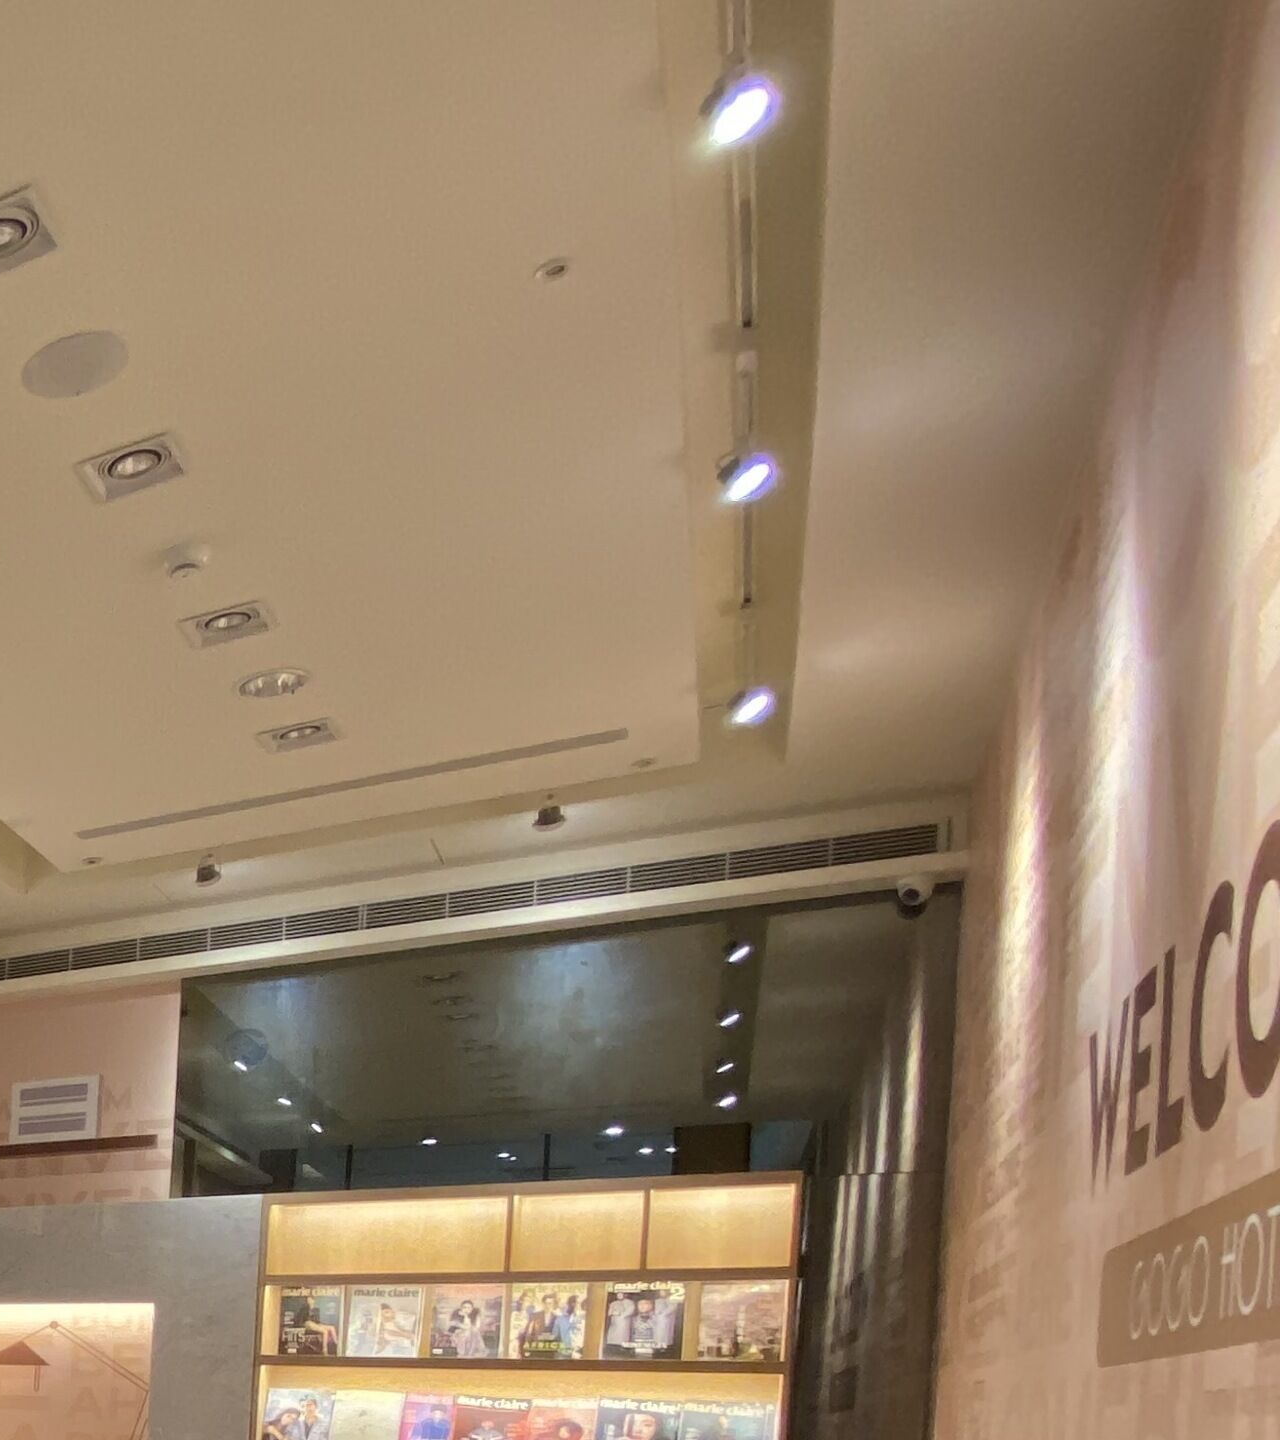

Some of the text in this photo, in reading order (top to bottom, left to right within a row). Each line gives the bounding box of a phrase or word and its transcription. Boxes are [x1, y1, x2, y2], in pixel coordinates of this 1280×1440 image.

[354, 1287, 419, 1297] marie claire
[1128, 1235, 1210, 1340] GOGO
[457, 1396, 493, 1408] marie
[495, 1399, 528, 1410] claire
[600, 1398, 638, 1410] marie
